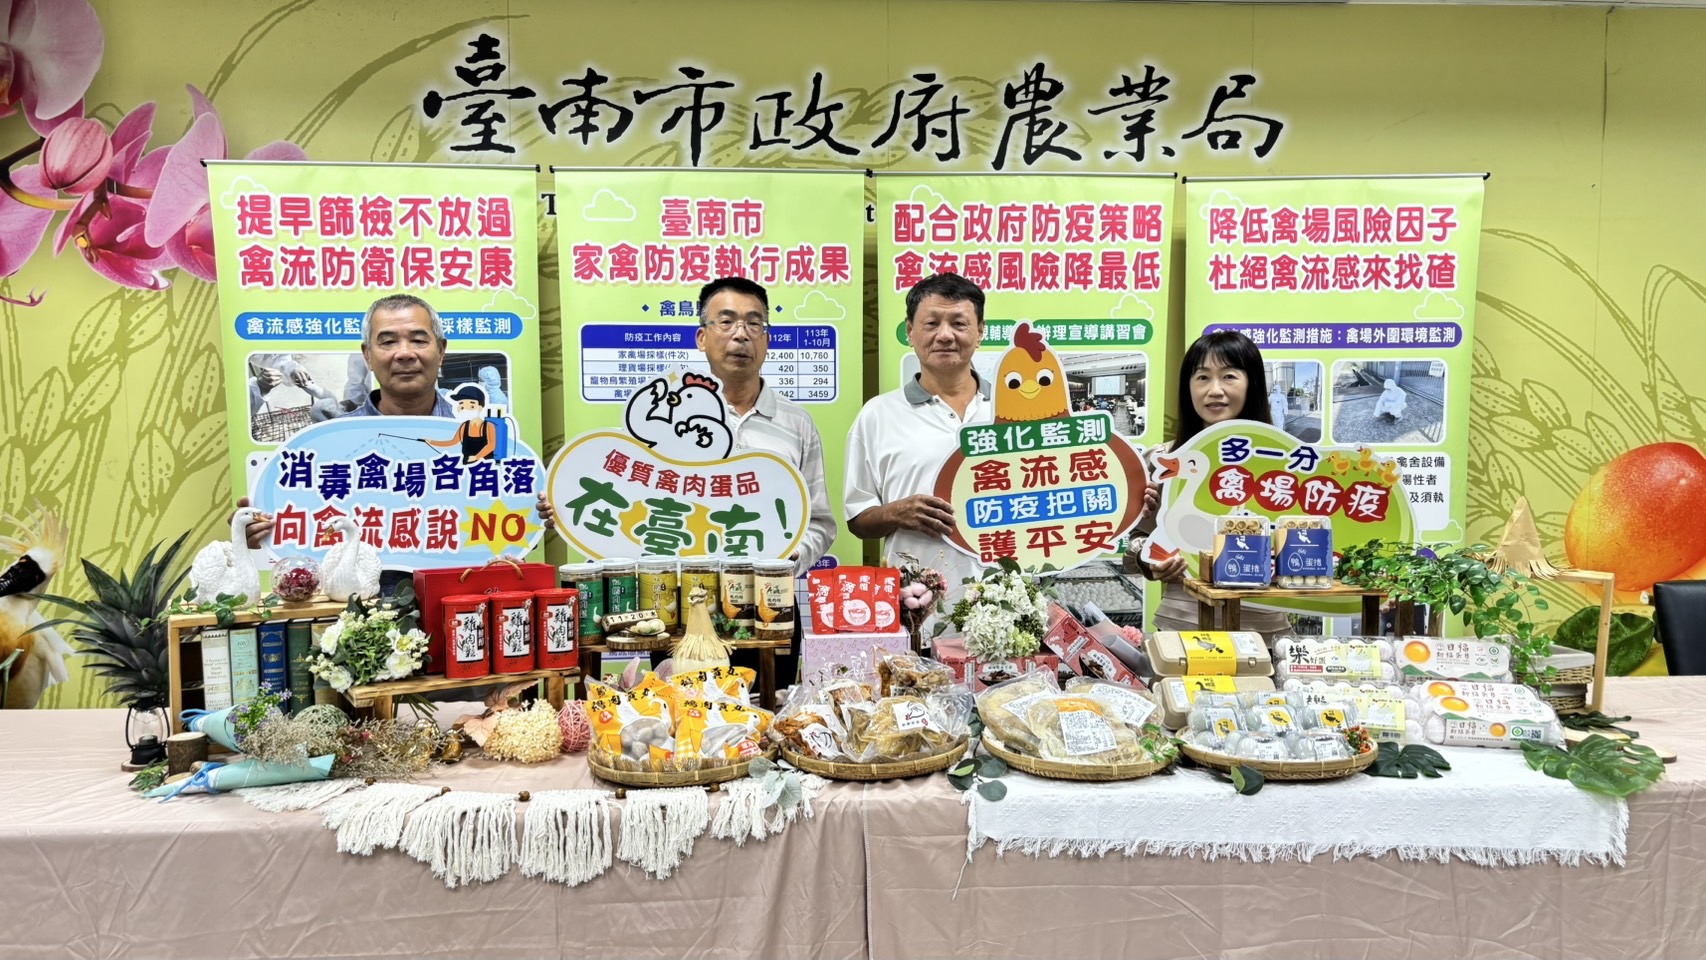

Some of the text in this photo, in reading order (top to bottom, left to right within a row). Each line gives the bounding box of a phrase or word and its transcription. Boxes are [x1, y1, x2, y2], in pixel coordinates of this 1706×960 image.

[423, 35, 1284, 169] 臺南市政府農業局
[237, 195, 512, 237] 提早篩檢不放過
[661, 198, 762, 237] 臺南市
[894, 203, 1162, 243] 配合政府防疫策略
[1209, 206, 1457, 244] 降低禽場風險因子
[238, 245, 513, 287] 禽流防衛保安康
[572, 243, 849, 282] 家禽防疫執行成果
[1208, 253, 1457, 290] 杜絕禽流感來找碴
[624, 332, 681, 342] 防疫工作內容
[804, 338, 830, 347] 1-10月
[805, 328, 828, 337] 113年
[801, 352, 828, 360] 10,760
[778, 377, 794, 385] 336
[808, 390, 829, 398] 3459
[813, 377, 828, 385] 294
[967, 417, 1106, 455] 強化監測
[1221, 437, 1319, 471] 多一分
[279, 450, 536, 501] 消毒禽場各角落
[603, 448, 760, 498] 優質禽肉蛋品
[970, 448, 1109, 493] 禽流感
[973, 487, 1113, 525] 防疫把關
[1215, 467, 1387, 519] 禽場防疫
[470, 512, 526, 542] NO
[978, 520, 1115, 563] 護平安
